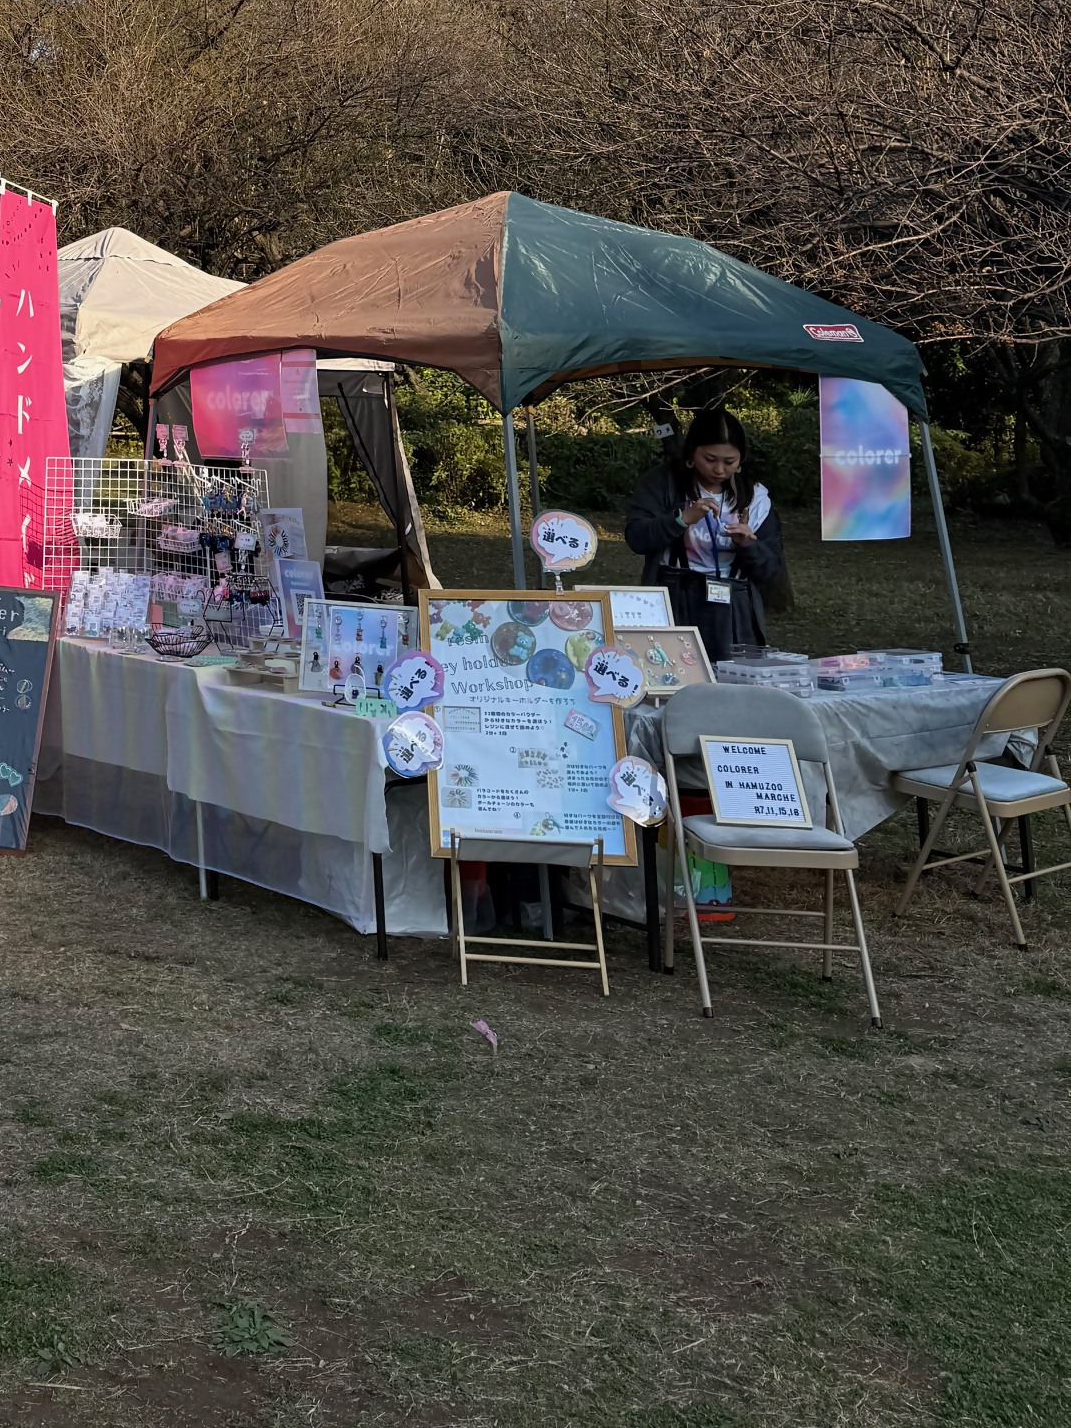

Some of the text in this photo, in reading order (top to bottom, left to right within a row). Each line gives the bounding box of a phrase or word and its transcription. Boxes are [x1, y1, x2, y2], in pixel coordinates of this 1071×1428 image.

[809, 326, 849, 338] Coleman
[835, 444, 902, 465] colorer
[447, 634, 490, 647] resin
[443, 662, 458, 675] ey
[450, 676, 534, 695] Workshop
[722, 745, 767, 755] WELCOME
[717, 764, 760, 774] COLORER
[725, 780, 783, 791] IN HAMUZOO
[756, 792, 797, 802] MARCHE
